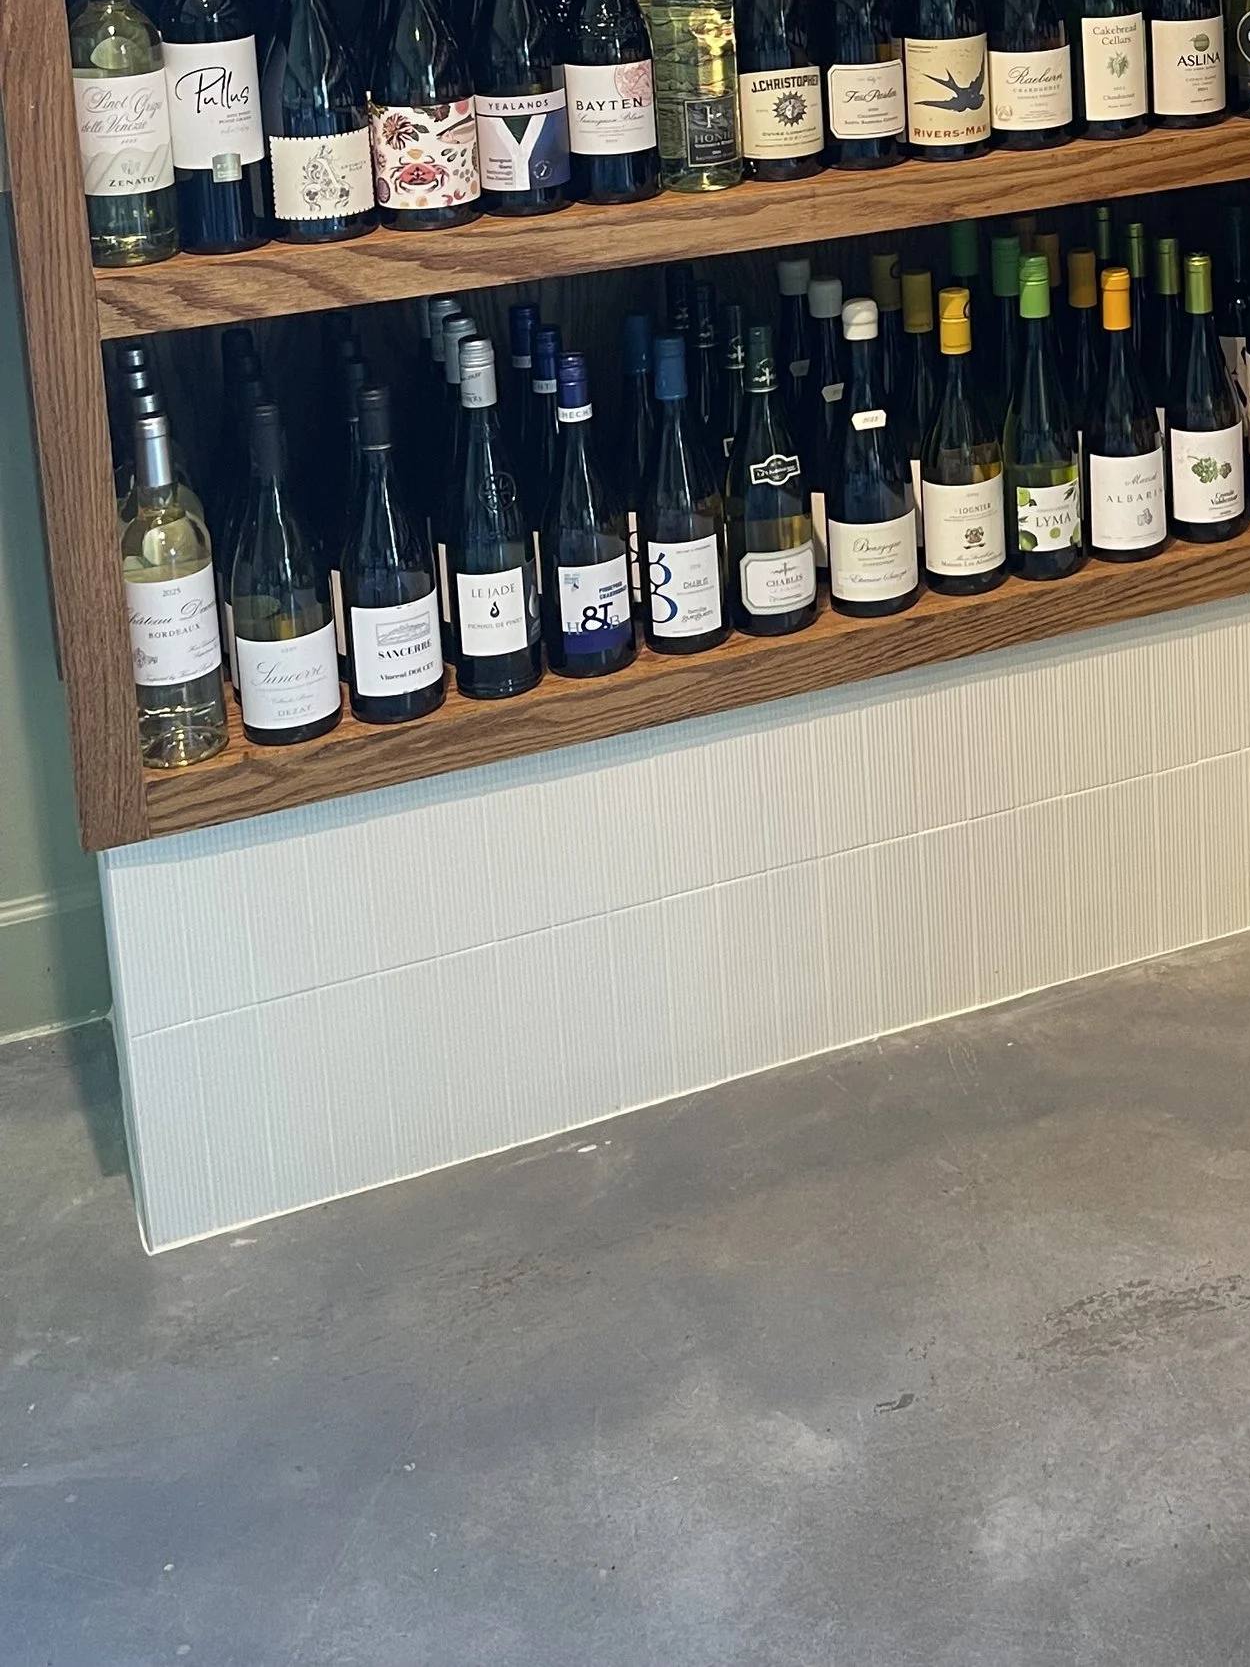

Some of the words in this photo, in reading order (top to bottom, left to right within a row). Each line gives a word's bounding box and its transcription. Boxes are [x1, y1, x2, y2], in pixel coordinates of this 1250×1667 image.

[1092, 22, 1137, 36] Cakebread
[1101, 35, 1132, 47] Cellars
[1176, 52, 1222, 67] ASLINA
[1005, 65, 1064, 87] Raeburn
[174, 66, 250, 114] Pullus
[487, 99, 549, 111] YEALANDS
[576, 96, 644, 112] BAYTEN
[108, 177, 155, 188] ZENATO
[1034, 510, 1073, 528] LYMA
[765, 573, 804, 588] CHABLIS
[471, 587, 485, 599] LE
[486, 583, 517, 599] JADE
[148, 624, 201, 639] BORDEAUX
[377, 638, 433, 661] SANCERRE
[251, 661, 324, 687] Sancerre
[277, 704, 312, 717] DEZAT
